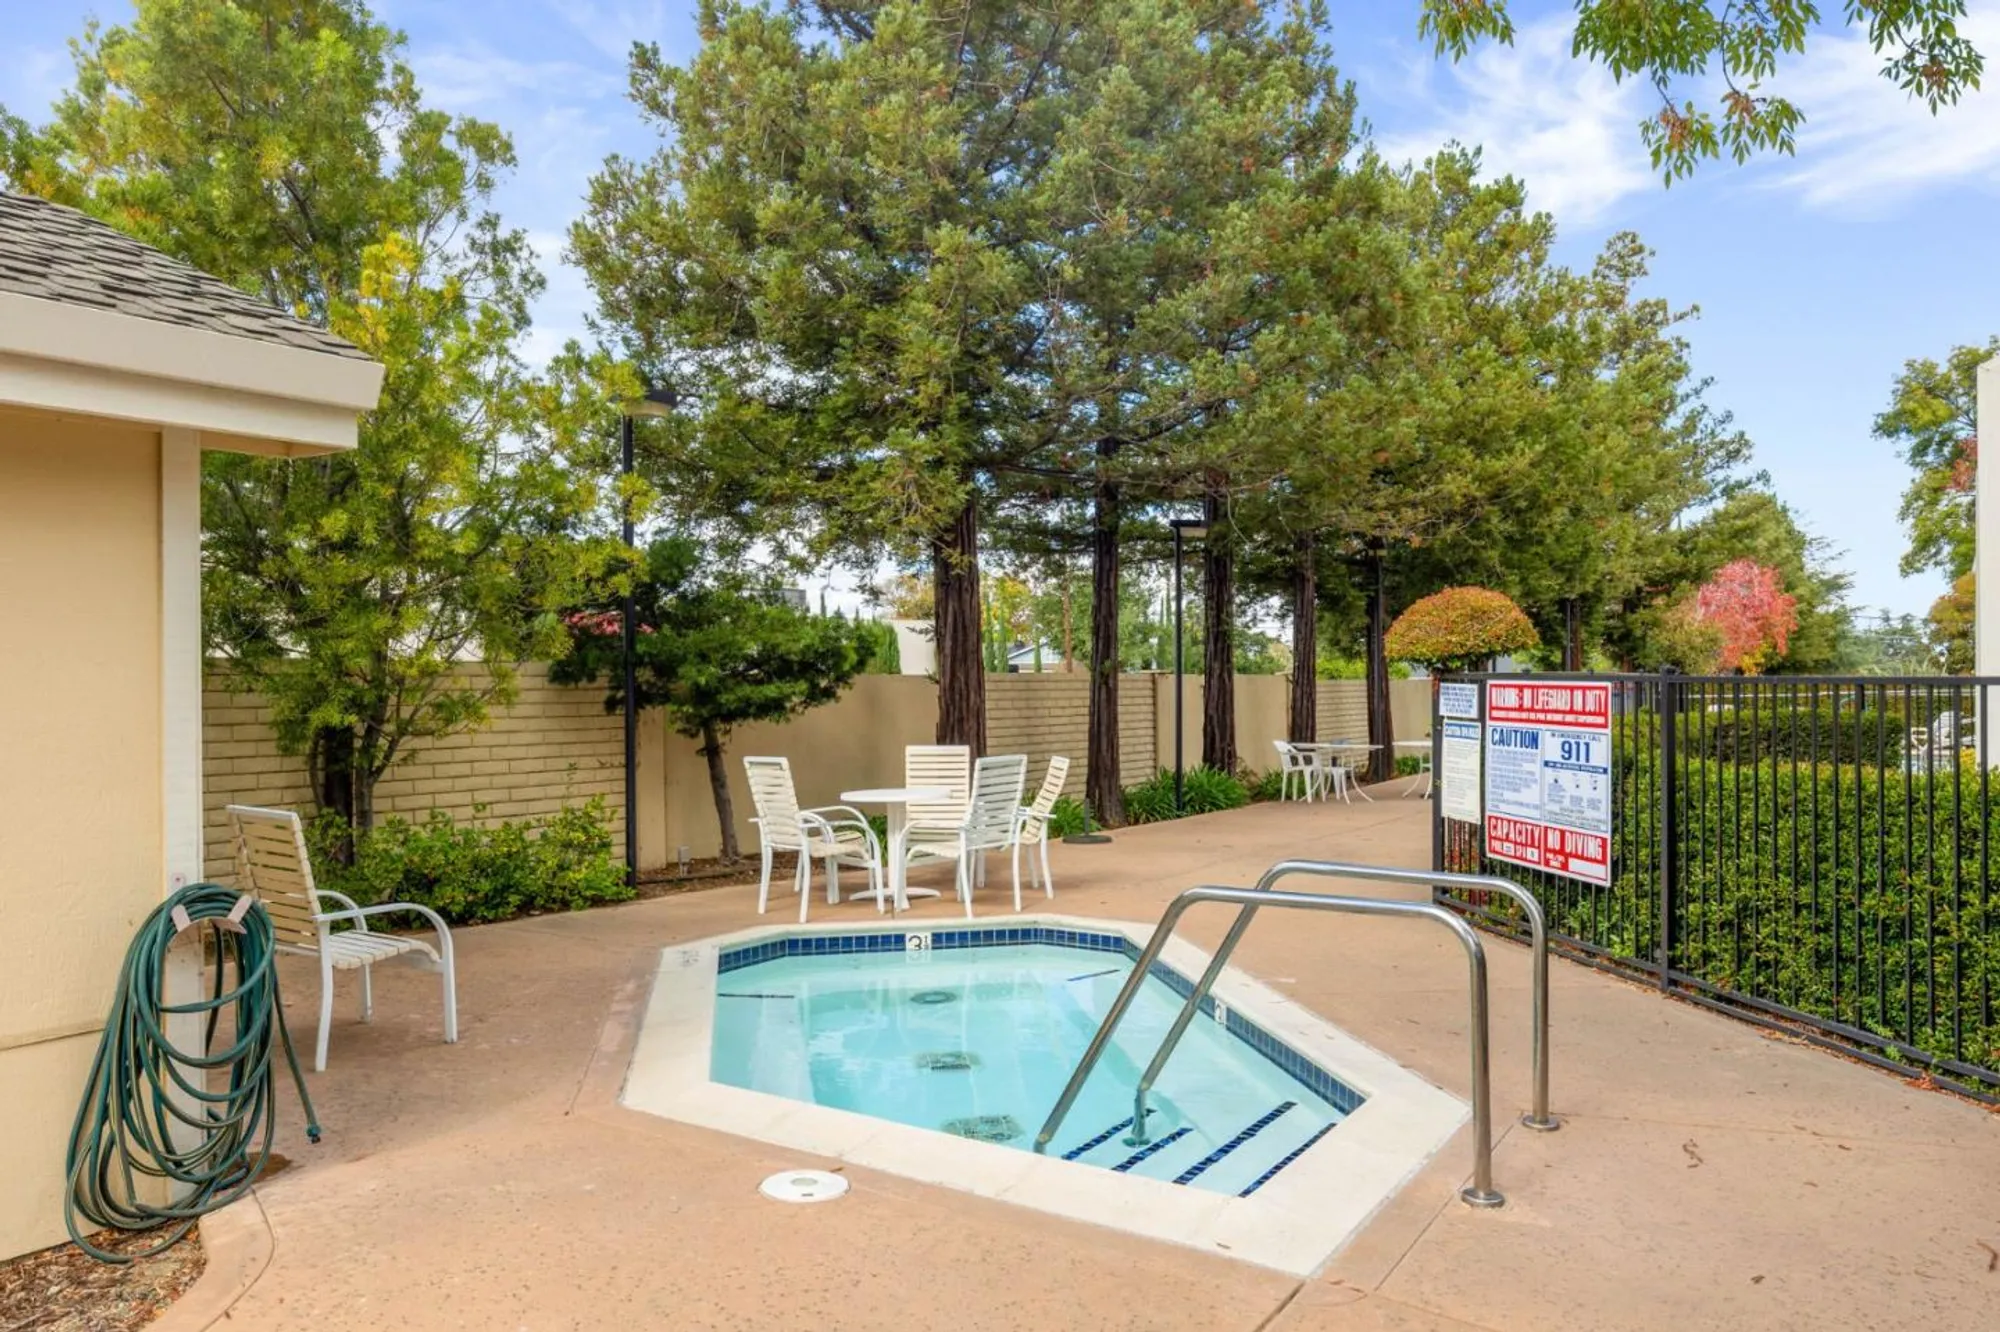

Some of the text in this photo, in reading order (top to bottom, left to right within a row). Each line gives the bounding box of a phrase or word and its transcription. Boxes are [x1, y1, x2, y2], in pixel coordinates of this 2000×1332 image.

[1491, 728, 1539, 750] CAUTION
[1561, 740, 1590, 763] 911
[1490, 817, 1540, 847] CAPACITY
[1547, 828, 1561, 850] NO
[1565, 831, 1603, 860] DIVING
